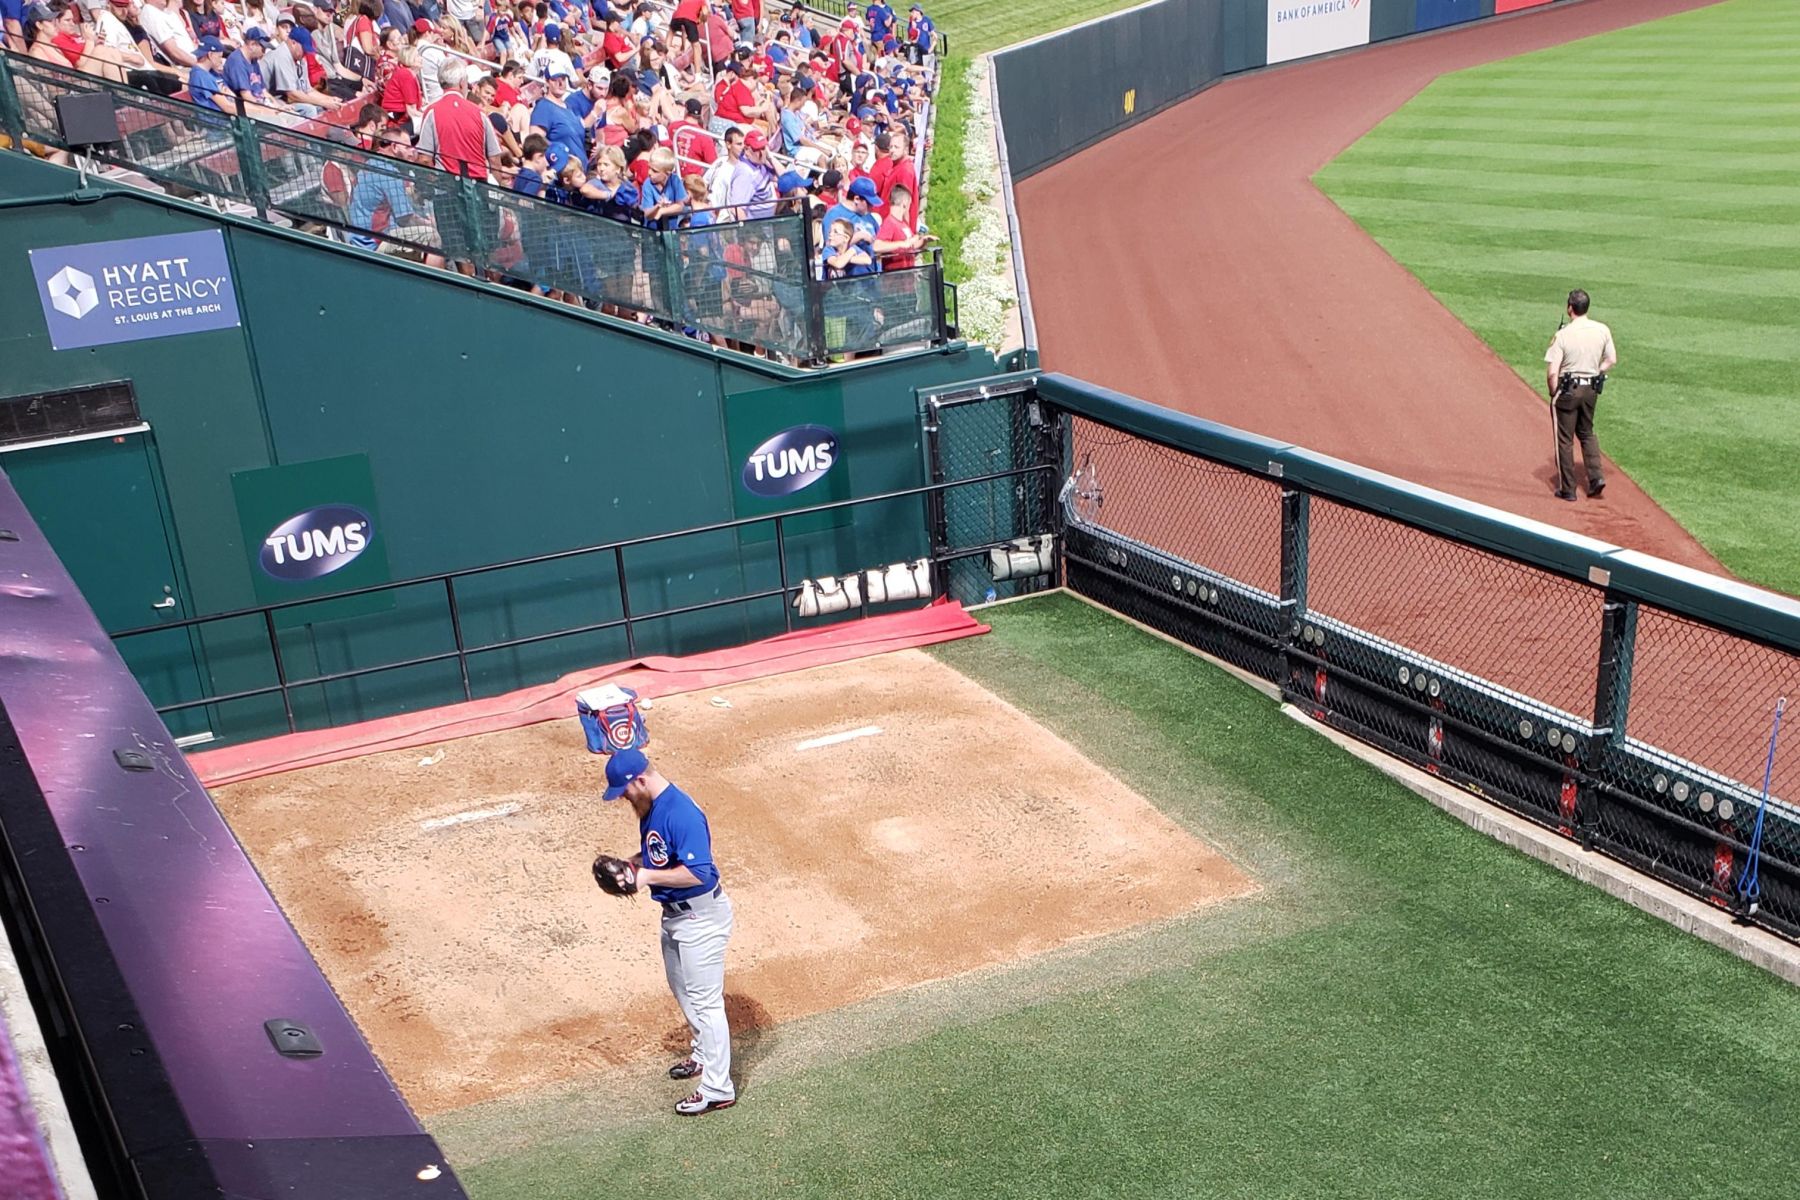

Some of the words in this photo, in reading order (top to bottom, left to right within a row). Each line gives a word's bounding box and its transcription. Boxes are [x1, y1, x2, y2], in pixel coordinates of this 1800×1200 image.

[1277, 8, 1299, 23] BANK
[1301, 6, 1311, 18] OF
[1312, 0, 1346, 17] AMERICA
[102, 258, 189, 286] HYATT
[108, 277, 222, 308] REGENCY
[115, 315, 129, 325] ST.
[131, 311, 159, 323] LOUIS
[161, 309, 173, 319] AT
[174, 306, 194, 317] THE
[195, 303, 222, 315] ARCH
[749, 442, 832, 481] TUMS
[265, 522, 366, 564] TUMS
